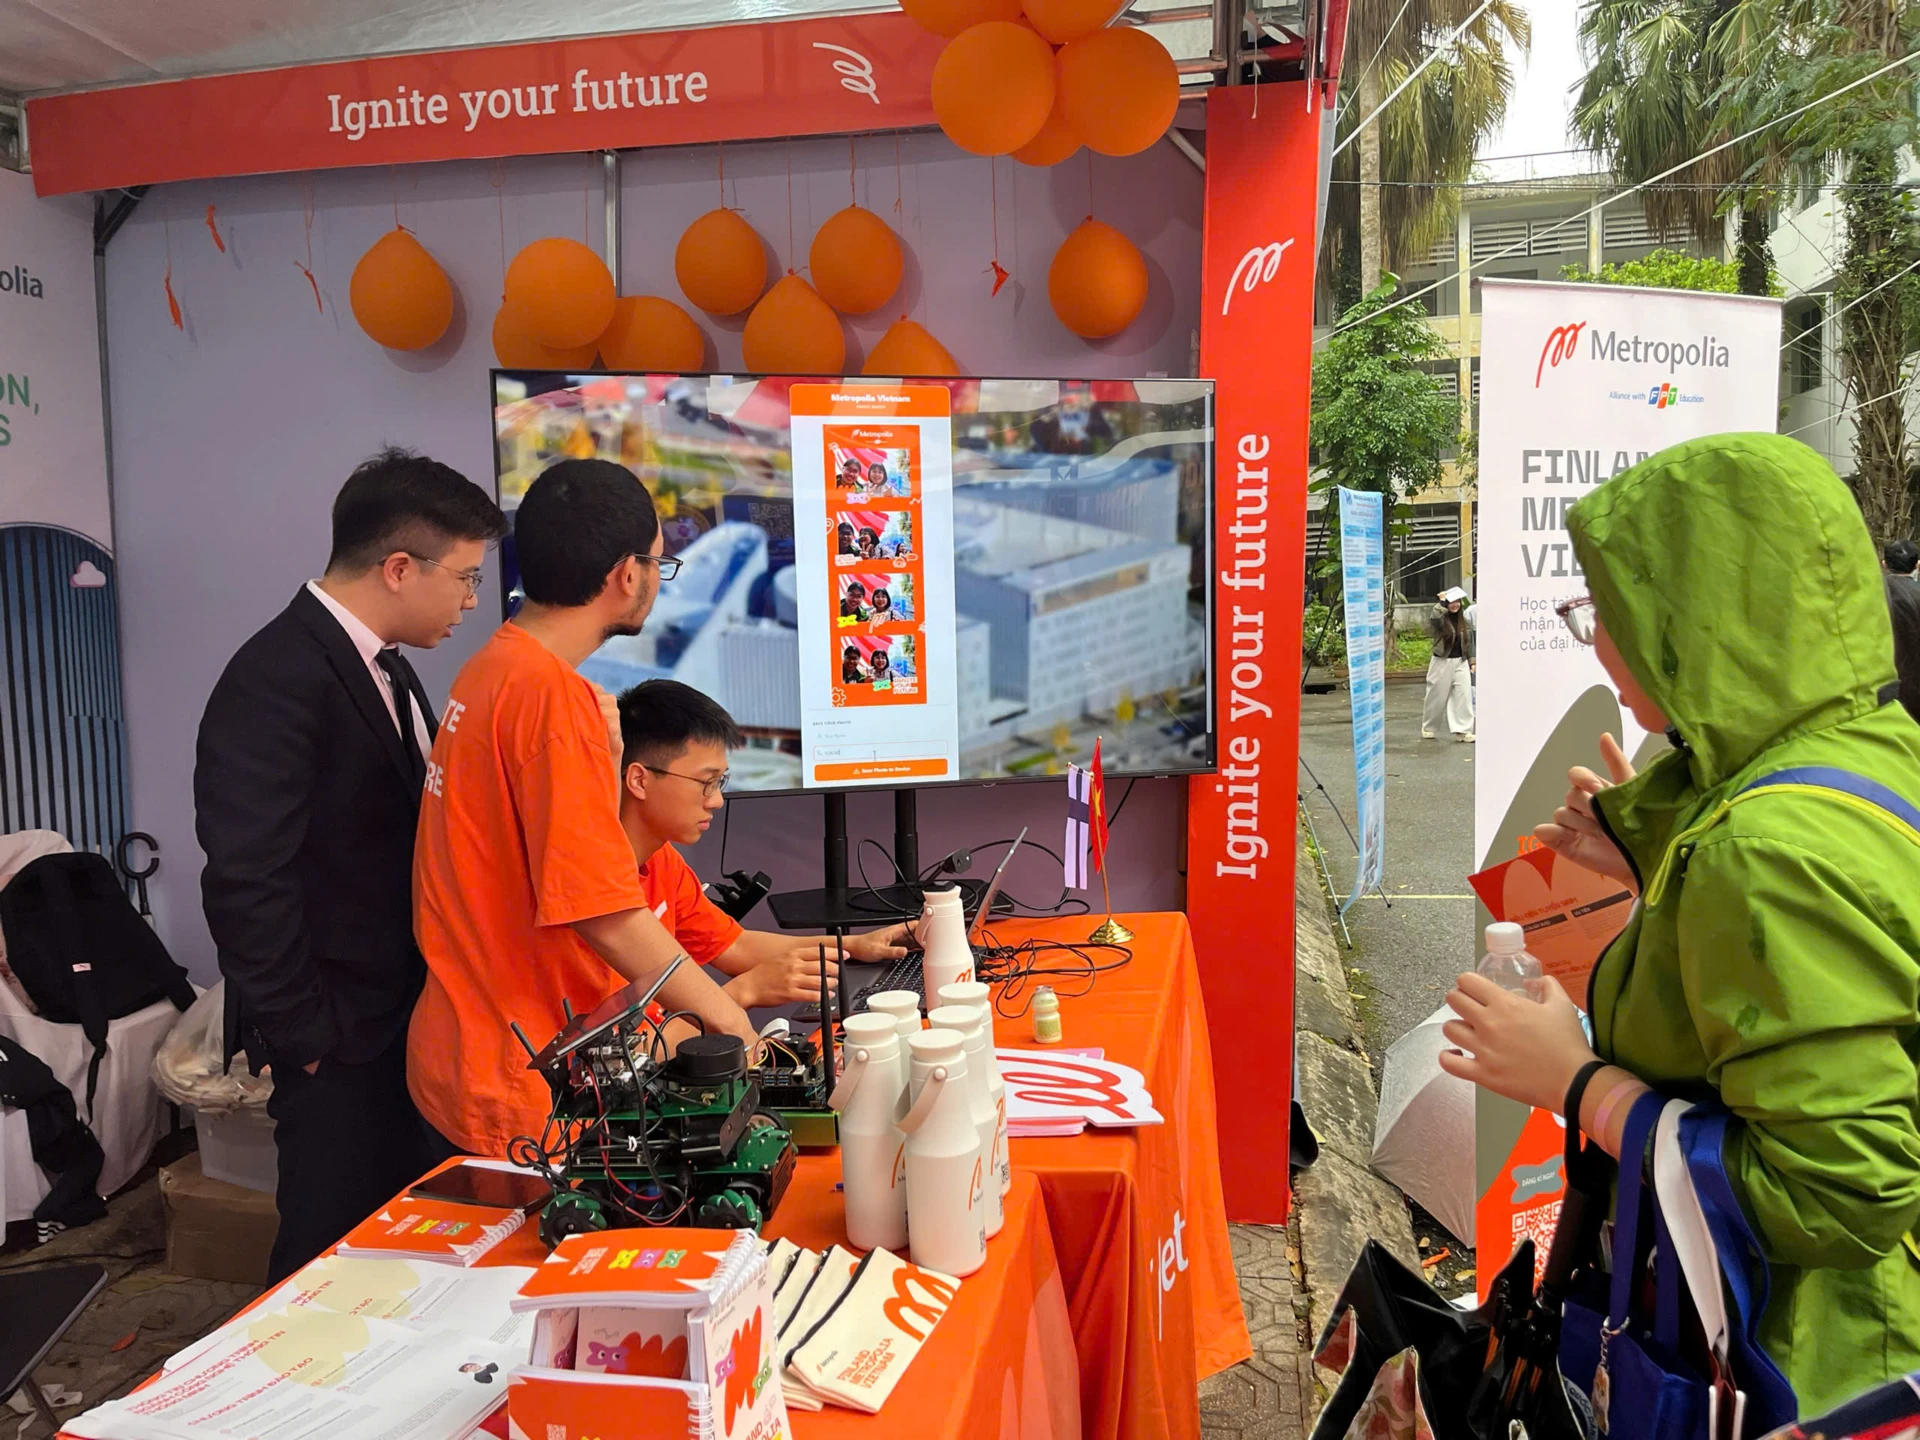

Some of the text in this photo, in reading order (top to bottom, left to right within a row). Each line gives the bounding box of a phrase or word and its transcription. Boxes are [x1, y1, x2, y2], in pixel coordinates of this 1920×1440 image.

[328, 69, 709, 141] Ignite your future
[1591, 329, 1730, 374] Metropolia
[830, 393, 911, 404] Metropolia Vietnam
[1608, 383, 1704, 409] Alliance with FPT Education
[859, 430, 894, 439] Metropolia
[1520, 596, 1547, 614] Học
[1520, 616, 1555, 634] nhận
[1520, 636, 1546, 651] của
[1549, 636, 1569, 652] đại
[1216, 433, 1273, 880] Ignite your future
